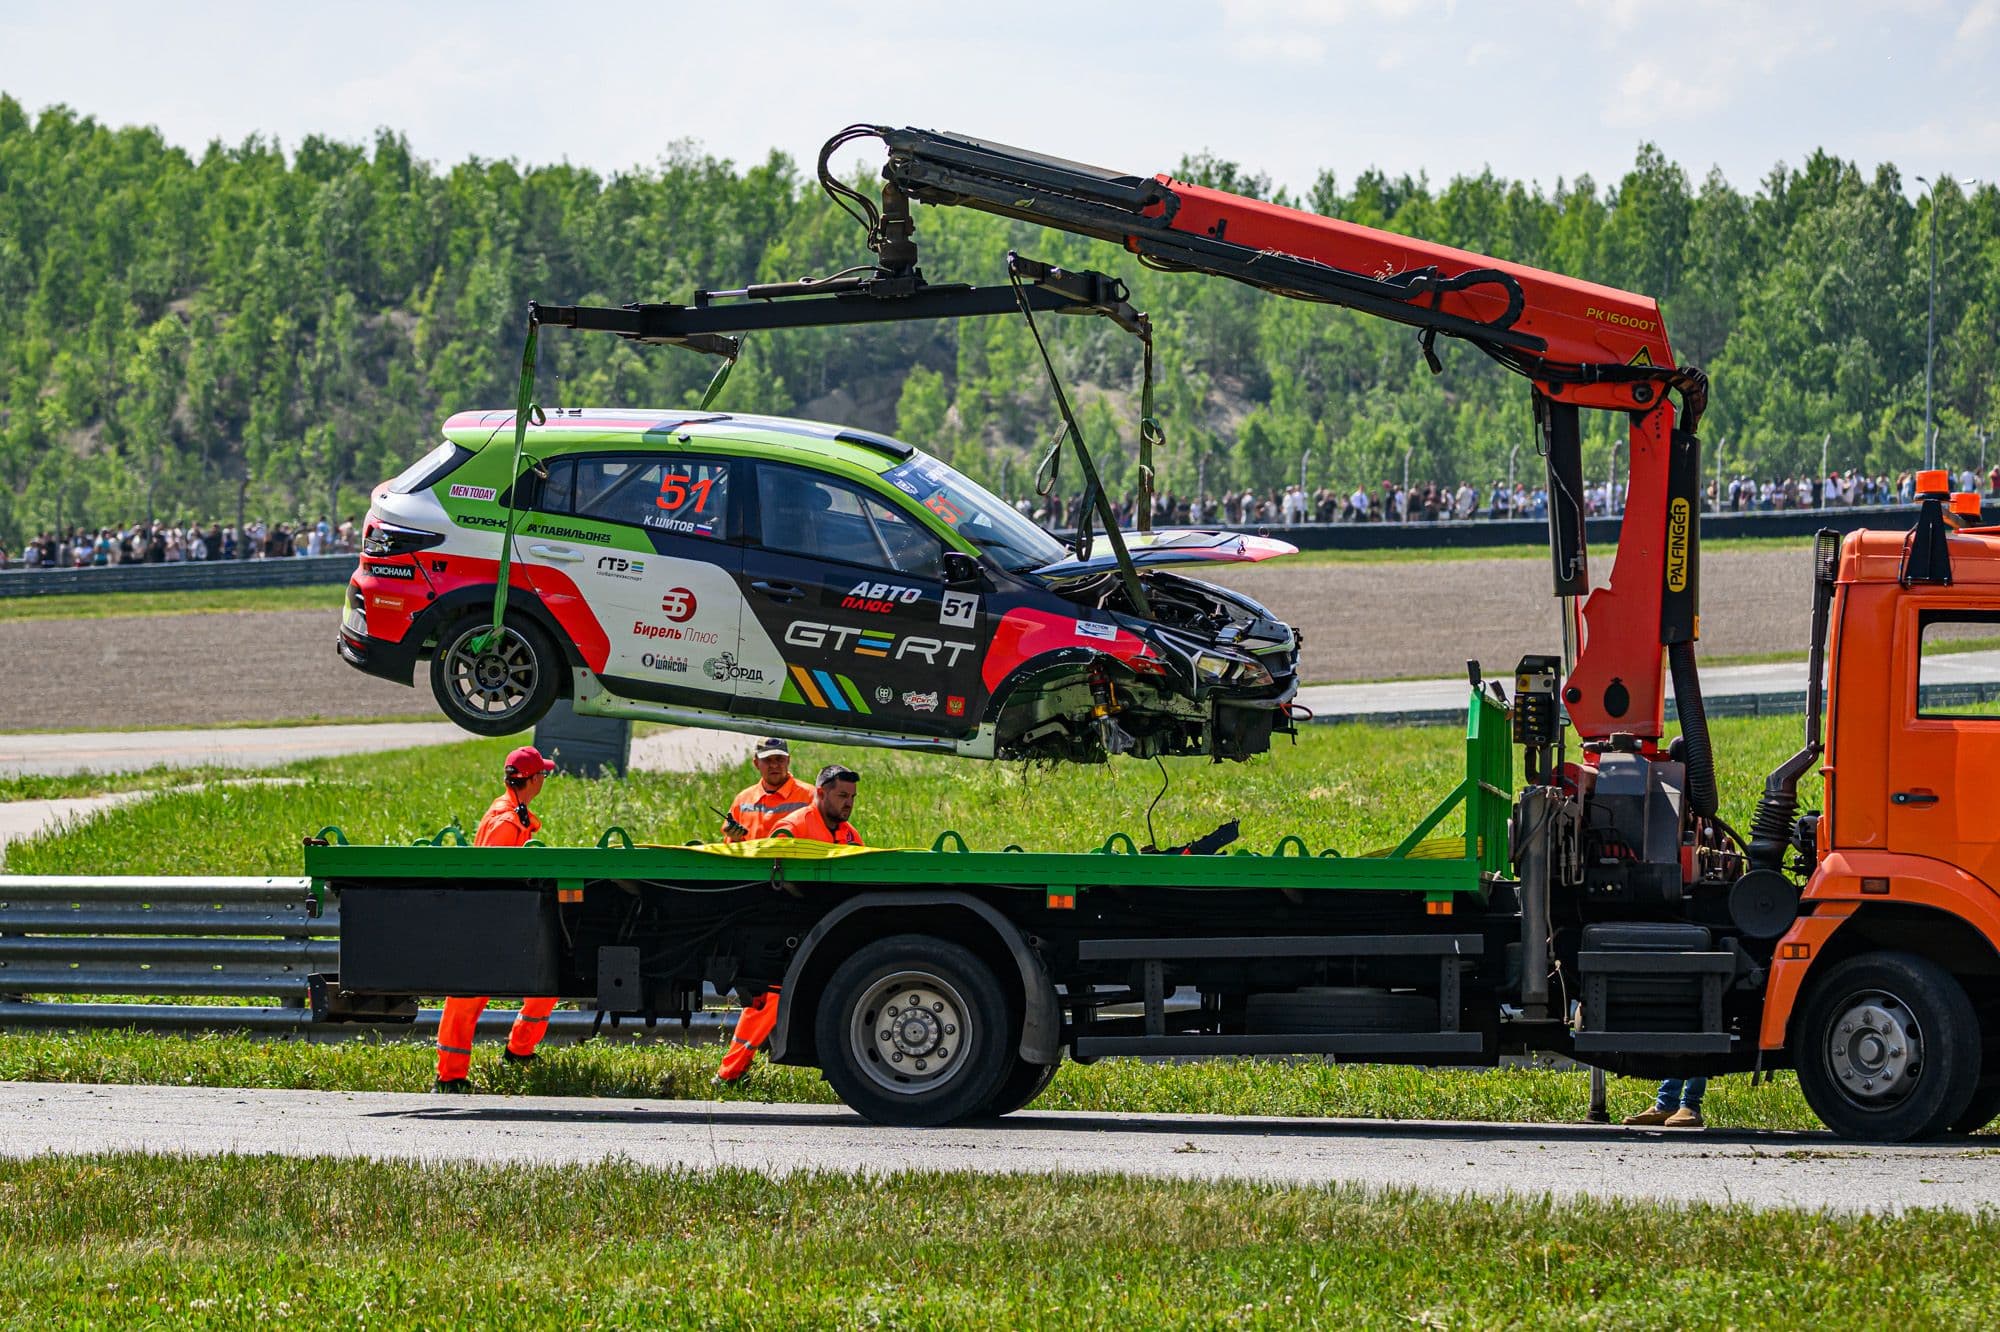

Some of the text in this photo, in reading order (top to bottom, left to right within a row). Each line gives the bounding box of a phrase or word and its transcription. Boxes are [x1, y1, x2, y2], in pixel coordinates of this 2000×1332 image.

[1586, 307, 1657, 332] PK 16000T
[451, 485, 495, 500] MEN TODAY
[656, 474, 713, 513] 51
[924, 495, 965, 525] 51
[643, 515, 695, 533] К.ШИТОВ
[1670, 504, 1690, 586] PALFINGER
[371, 565, 412, 577] YOKOHAMA
[848, 581, 922, 604] АВТО
[841, 596, 894, 613] ПЛЮС
[943, 599, 974, 619] 51
[633, 621, 719, 644] Бирель Плюс
[655, 659, 688, 673] ШАНСОН
[656, 653, 688, 662] РАДИО
[729, 667, 763, 681] ОРДА
